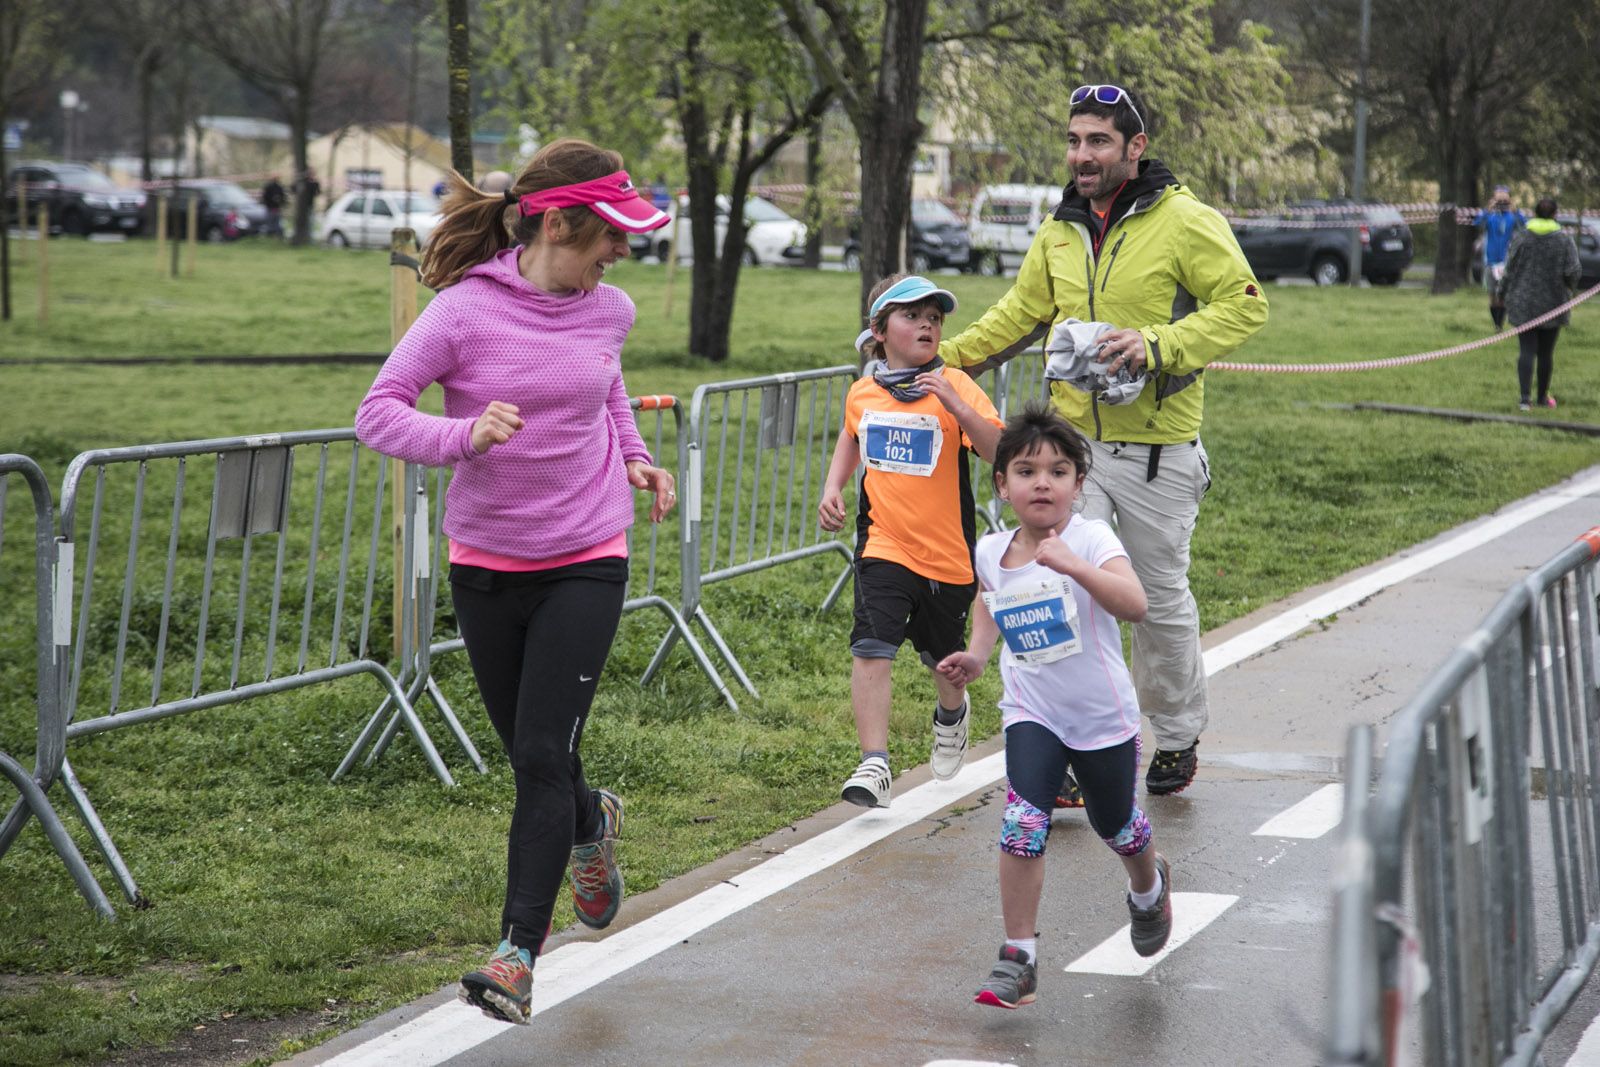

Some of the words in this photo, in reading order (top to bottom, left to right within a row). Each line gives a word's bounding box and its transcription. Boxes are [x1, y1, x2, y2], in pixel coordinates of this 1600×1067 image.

[886, 429, 911, 445] JAN
[884, 446, 913, 462] 1021
[1003, 606, 1054, 630] ARIADNA
[1018, 628, 1050, 650] 1031
